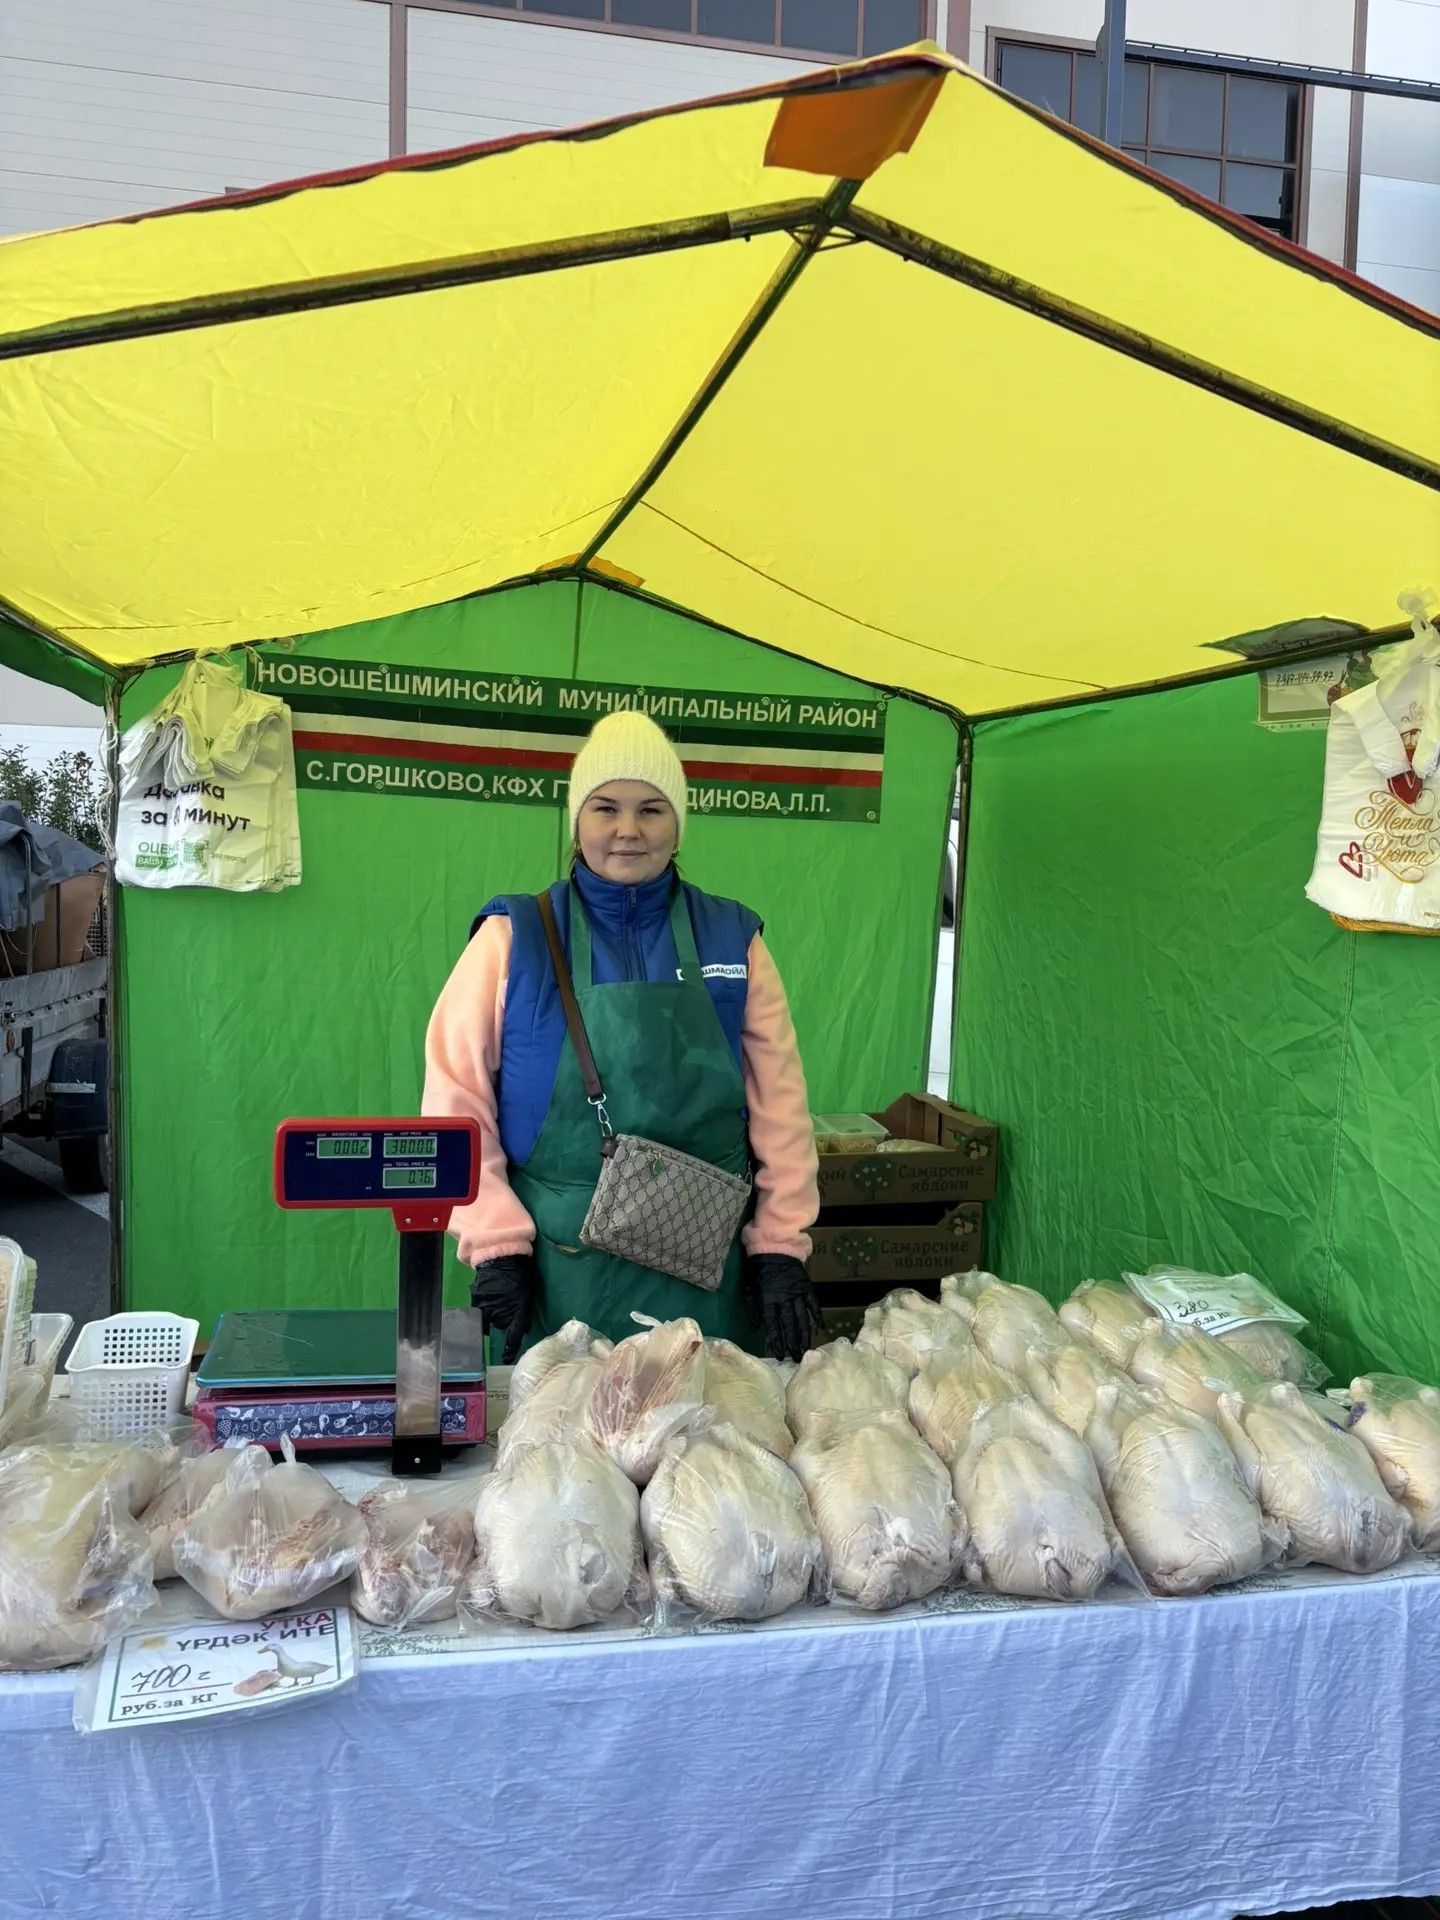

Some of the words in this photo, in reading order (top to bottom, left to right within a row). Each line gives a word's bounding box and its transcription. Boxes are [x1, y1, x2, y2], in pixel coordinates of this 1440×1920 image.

[257, 661, 543, 707] НОВОШЕШМИНСКИЙ
[558, 687, 791, 723] МУНИЦИПАЛЬНЫЙ
[798, 701, 878, 729] РАЙОН
[686, 788, 782, 812] ДИНОВА
[141, 810, 168, 826] за
[184, 807, 251, 831] минут
[898, 1163, 985, 1181] Самарские
[880, 1238, 969, 1257] Самарские
[1173, 1299, 1210, 1318] 380
[260, 1612, 333, 1632] УТКА
[279, 1623, 335, 1640] ИТЕ
[130, 1663, 191, 1693] 700
